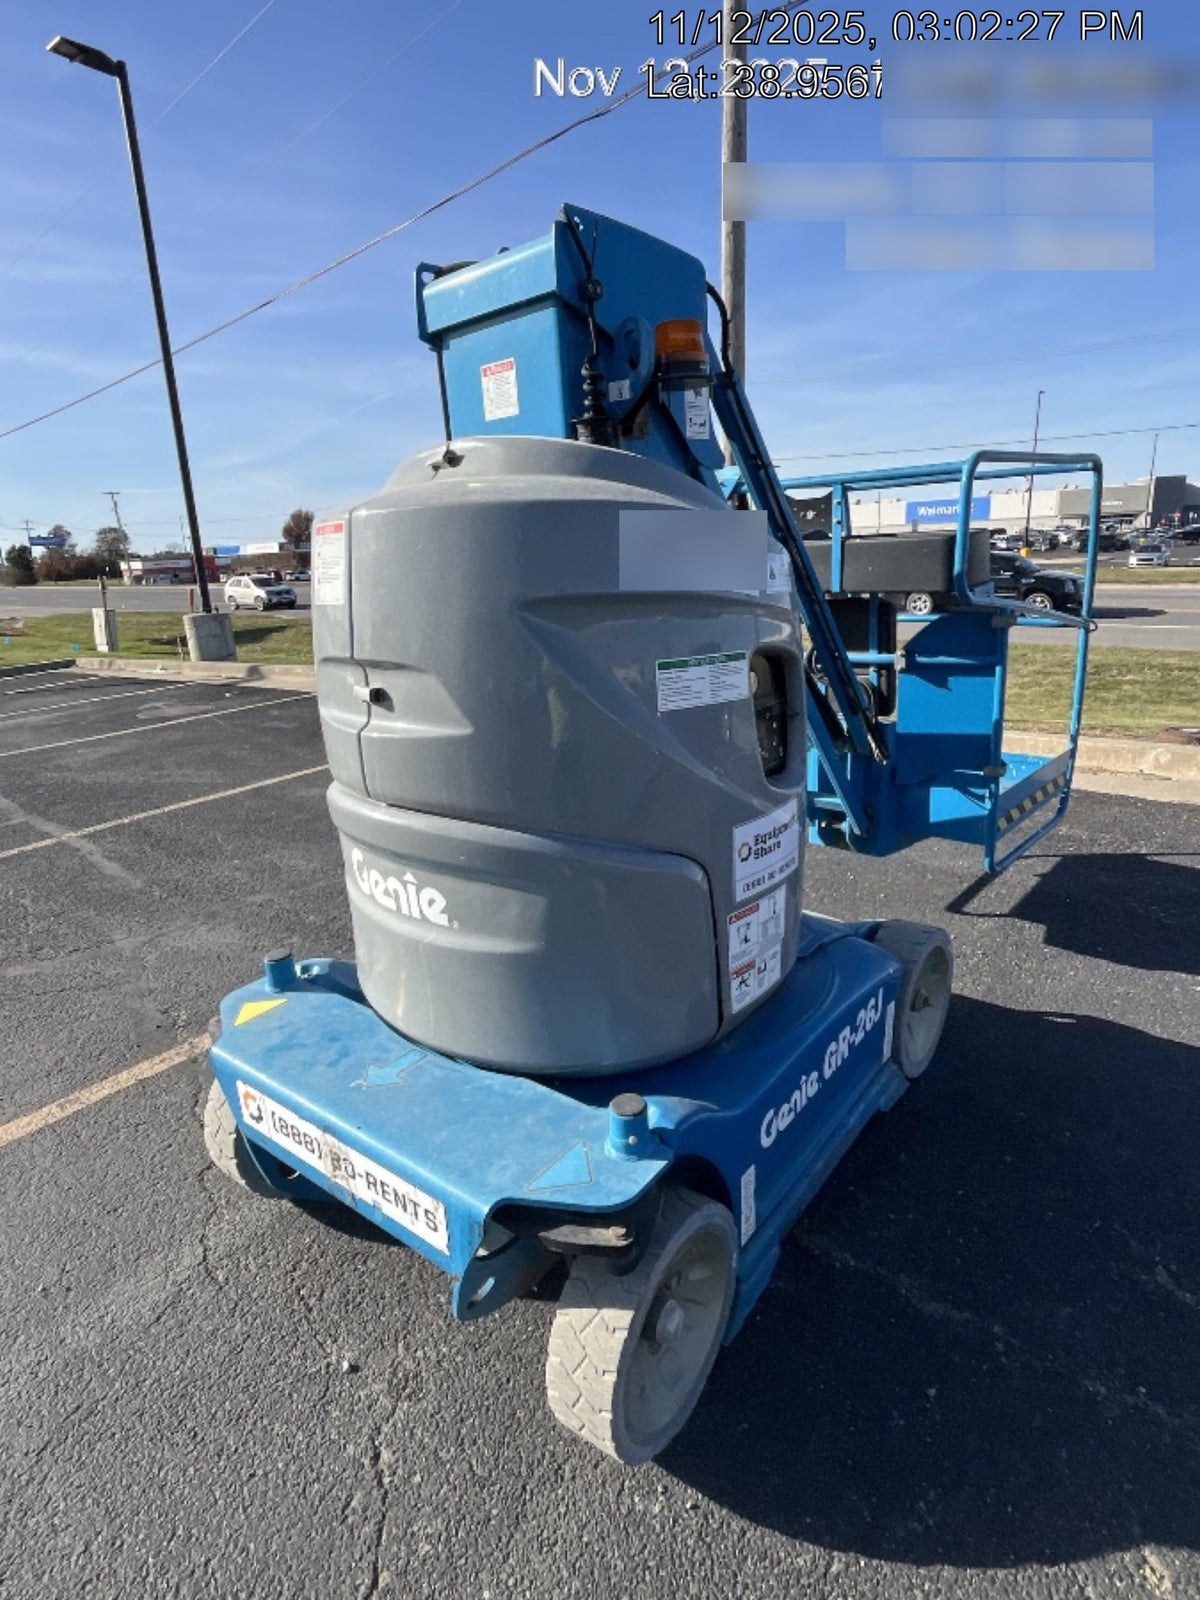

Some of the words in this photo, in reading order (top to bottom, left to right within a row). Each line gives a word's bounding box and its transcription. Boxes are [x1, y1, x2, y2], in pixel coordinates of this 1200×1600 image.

[917, 505, 961, 517] Walmar
[753, 841, 782, 860] Share
[351, 847, 451, 927] Genie
[760, 1070, 820, 1148] Genie
[823, 987, 884, 1080] GR-26J
[270, 1110, 324, 1160] (888)
